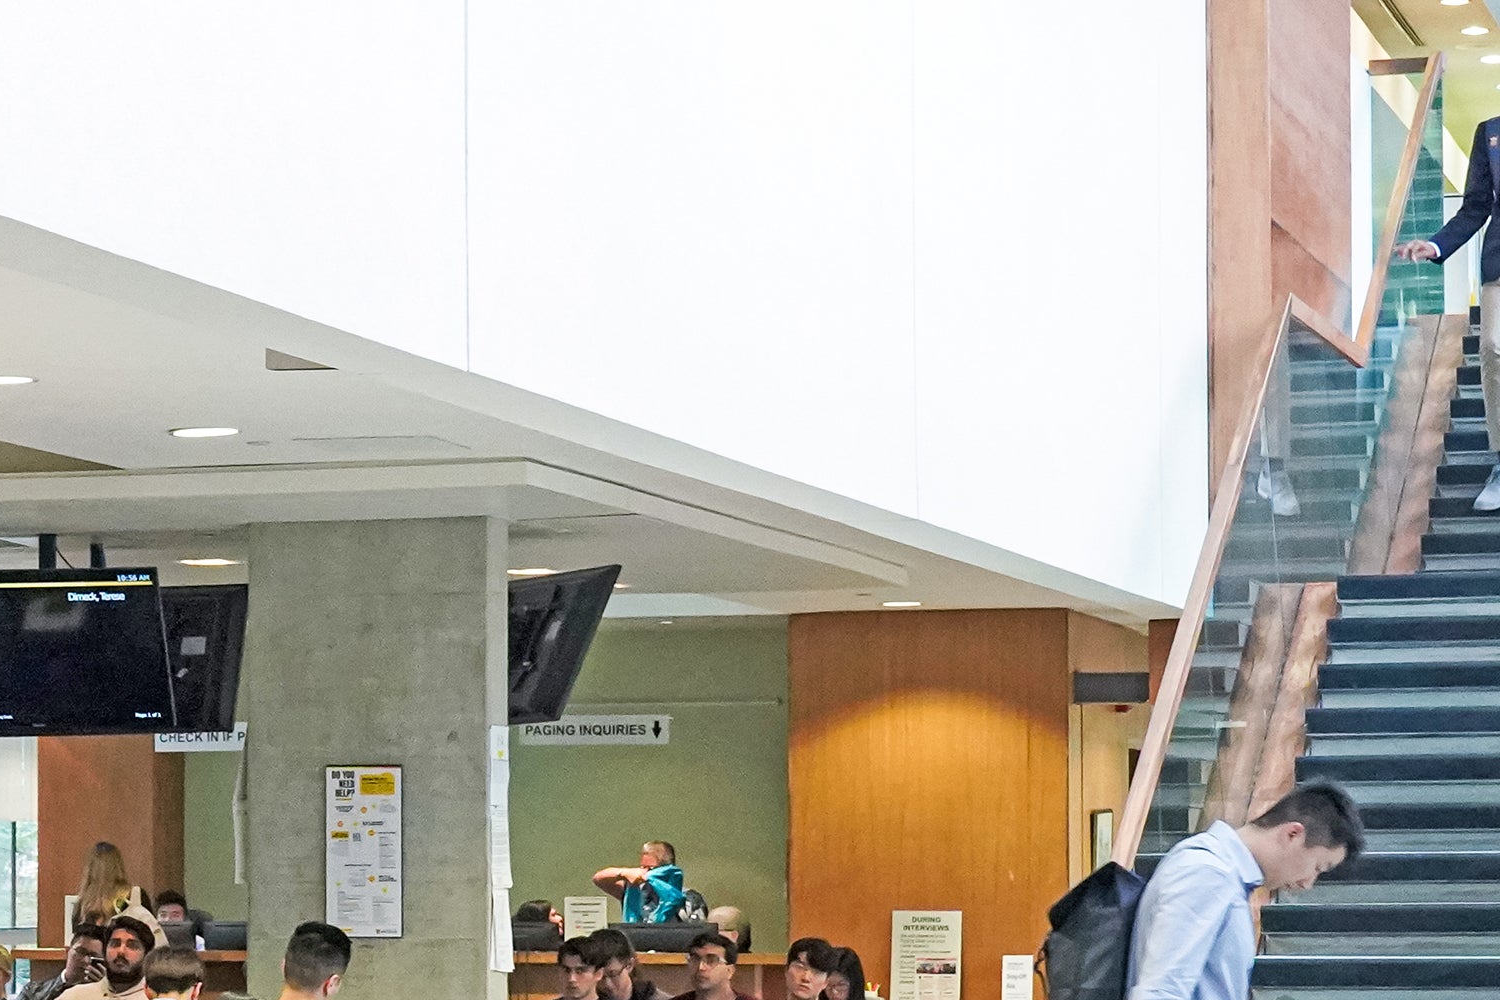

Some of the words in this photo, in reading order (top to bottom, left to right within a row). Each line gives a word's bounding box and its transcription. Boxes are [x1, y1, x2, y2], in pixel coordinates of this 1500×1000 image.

[526, 725, 575, 736] PAGING
[580, 725, 647, 736] INQUIRIES
[159, 733, 203, 743] CHECK
[208, 732, 219, 742] IN
[223, 732, 233, 742] IF
